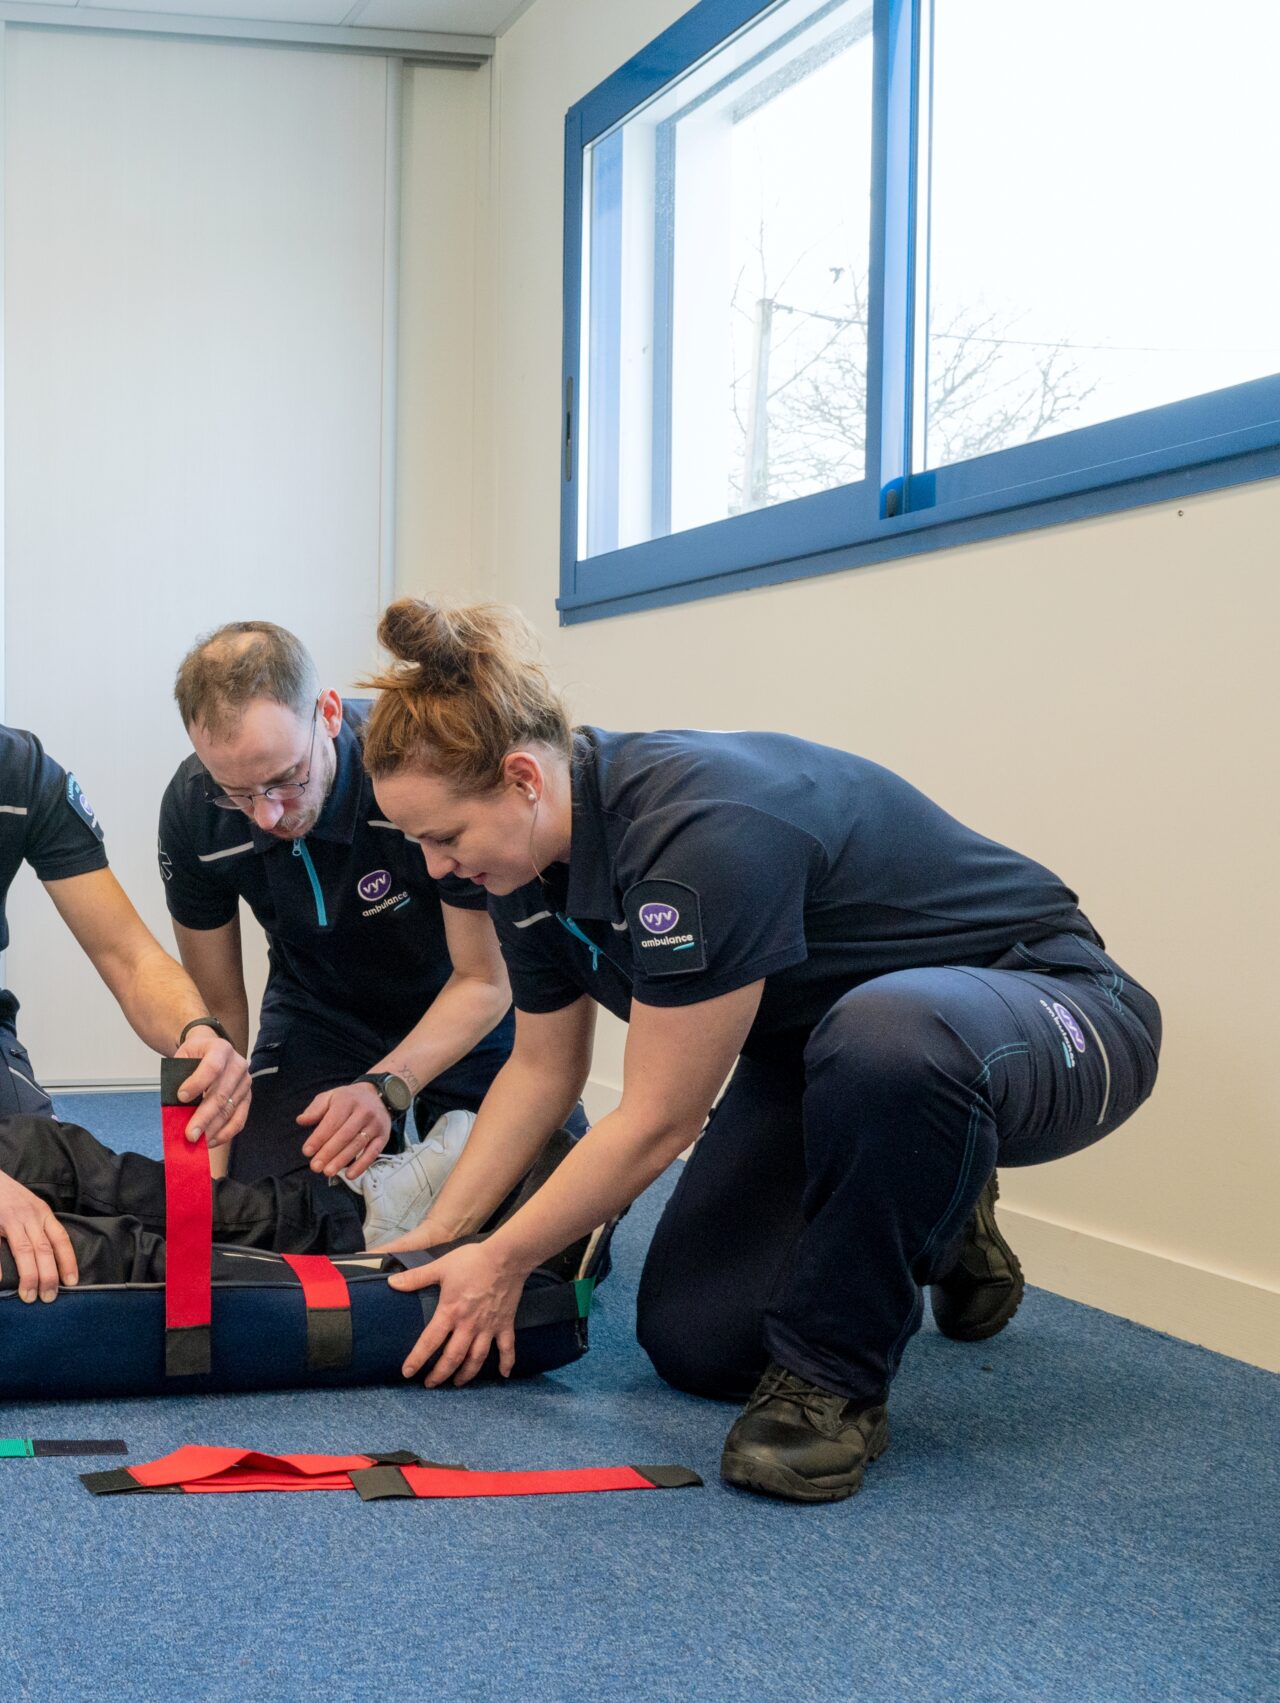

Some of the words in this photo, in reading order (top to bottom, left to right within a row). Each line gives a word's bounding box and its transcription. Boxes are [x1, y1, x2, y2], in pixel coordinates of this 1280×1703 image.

[362, 873, 386, 893] vyv
[362, 891, 409, 917] ambulance
[644, 910, 672, 926] vyv
[641, 934, 694, 948] ambulance
